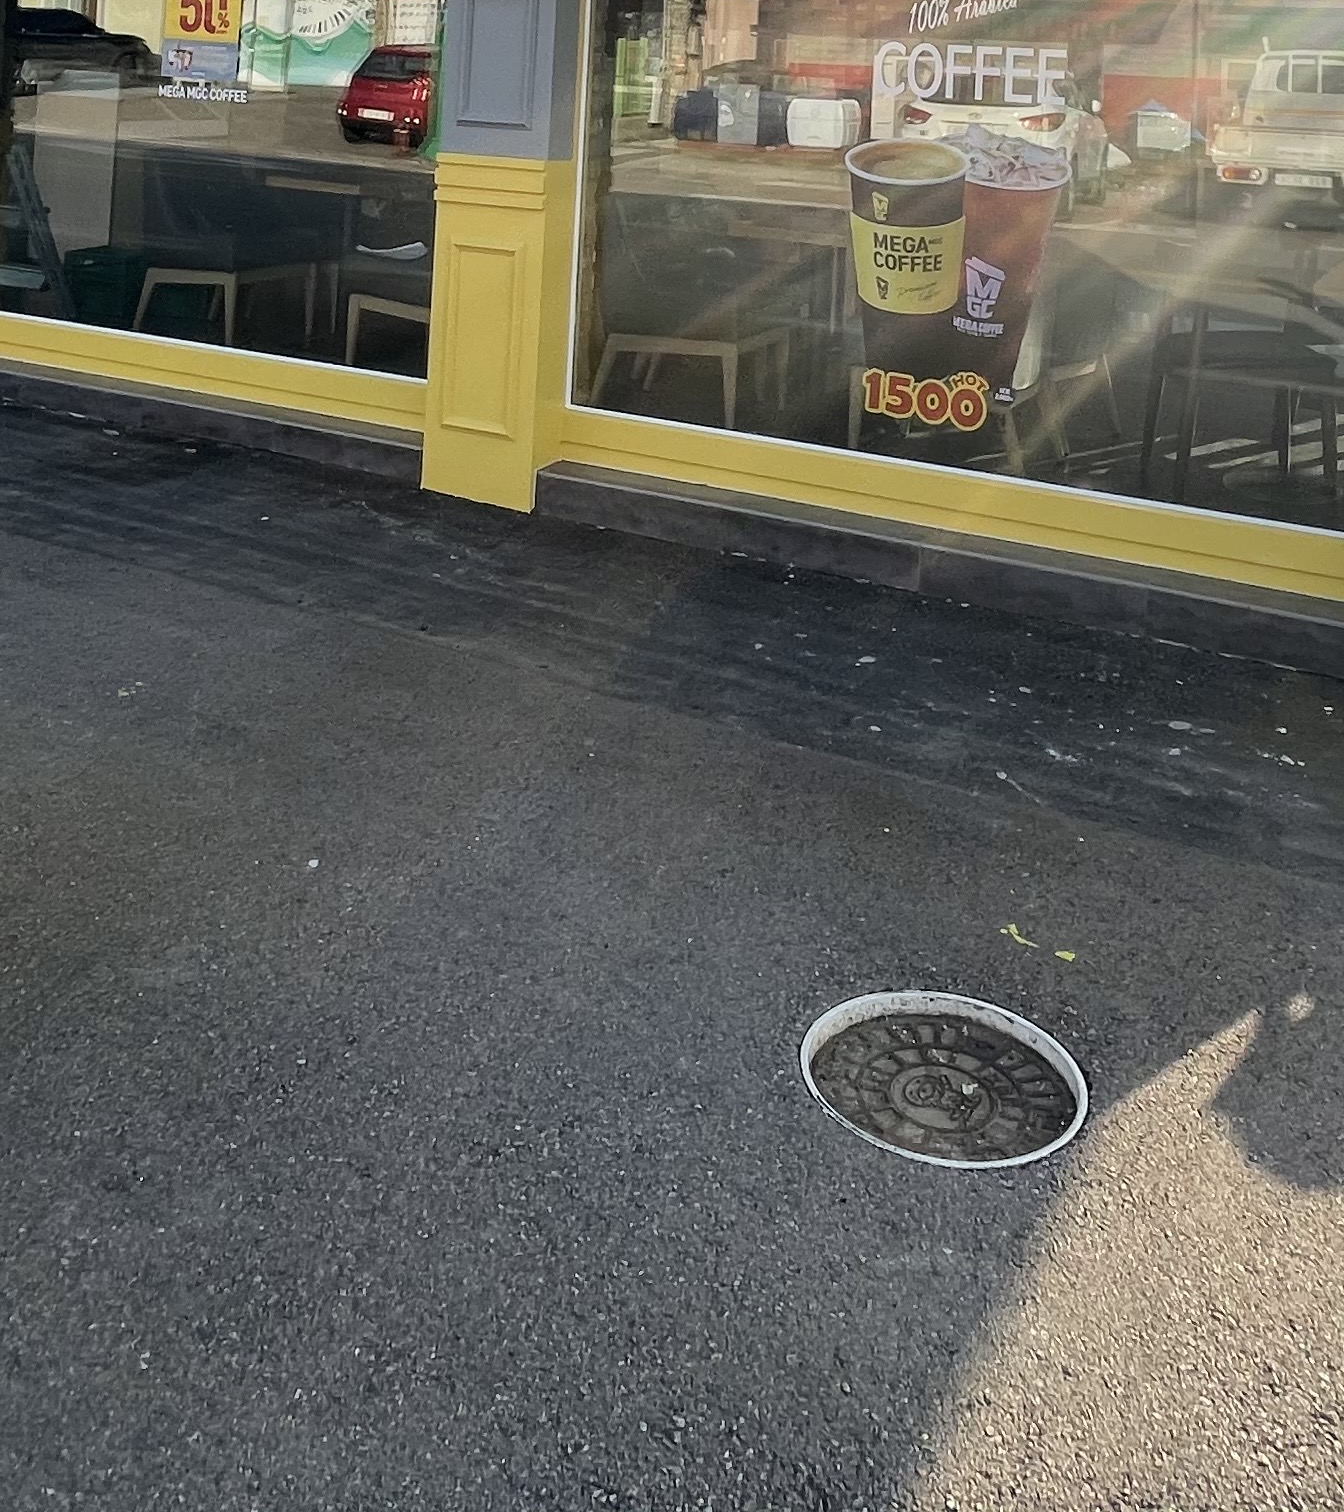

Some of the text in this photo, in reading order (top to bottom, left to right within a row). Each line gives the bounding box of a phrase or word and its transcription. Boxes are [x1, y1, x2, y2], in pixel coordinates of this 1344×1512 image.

[874, 41, 1068, 106] COFFEE
[158, 84, 248, 104] MEGA MGC COFFEE
[873, 232, 930, 254] MEGA
[873, 252, 943, 273] COFFEE
[952, 373, 986, 390] HOT
[864, 371, 985, 429] 1500
